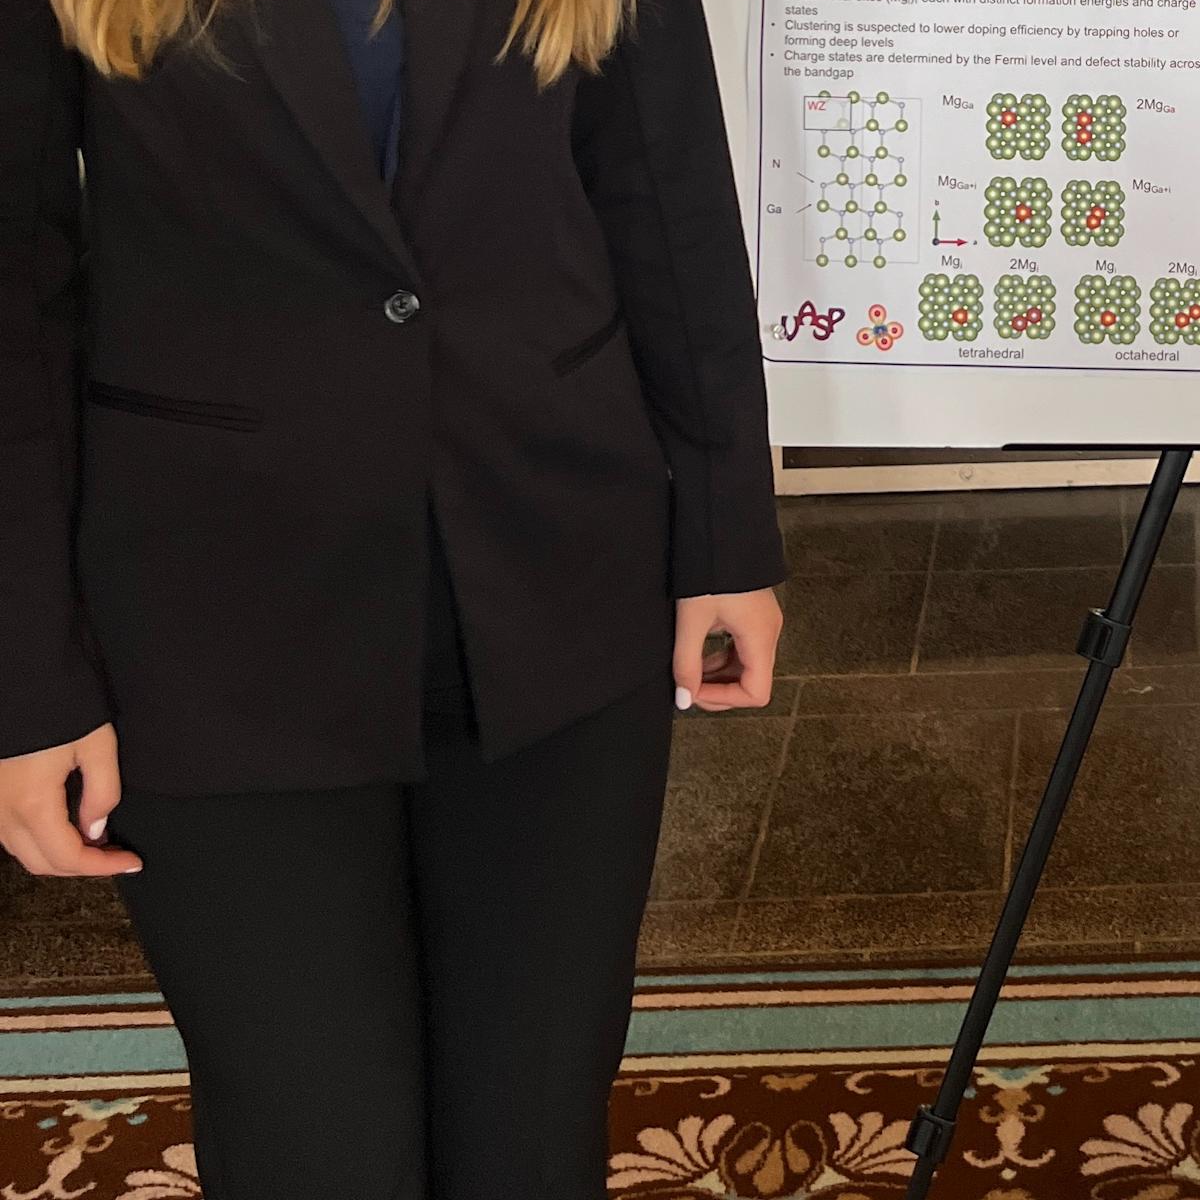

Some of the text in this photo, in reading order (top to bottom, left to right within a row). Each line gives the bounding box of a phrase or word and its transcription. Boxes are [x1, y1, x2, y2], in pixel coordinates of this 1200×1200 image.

[783, 34, 894, 51] forming deep levels
[783, 66, 854, 80] the bandgap
[958, 347, 1024, 359] tetrahedral
[1114, 349, 1179, 361] octahedral
